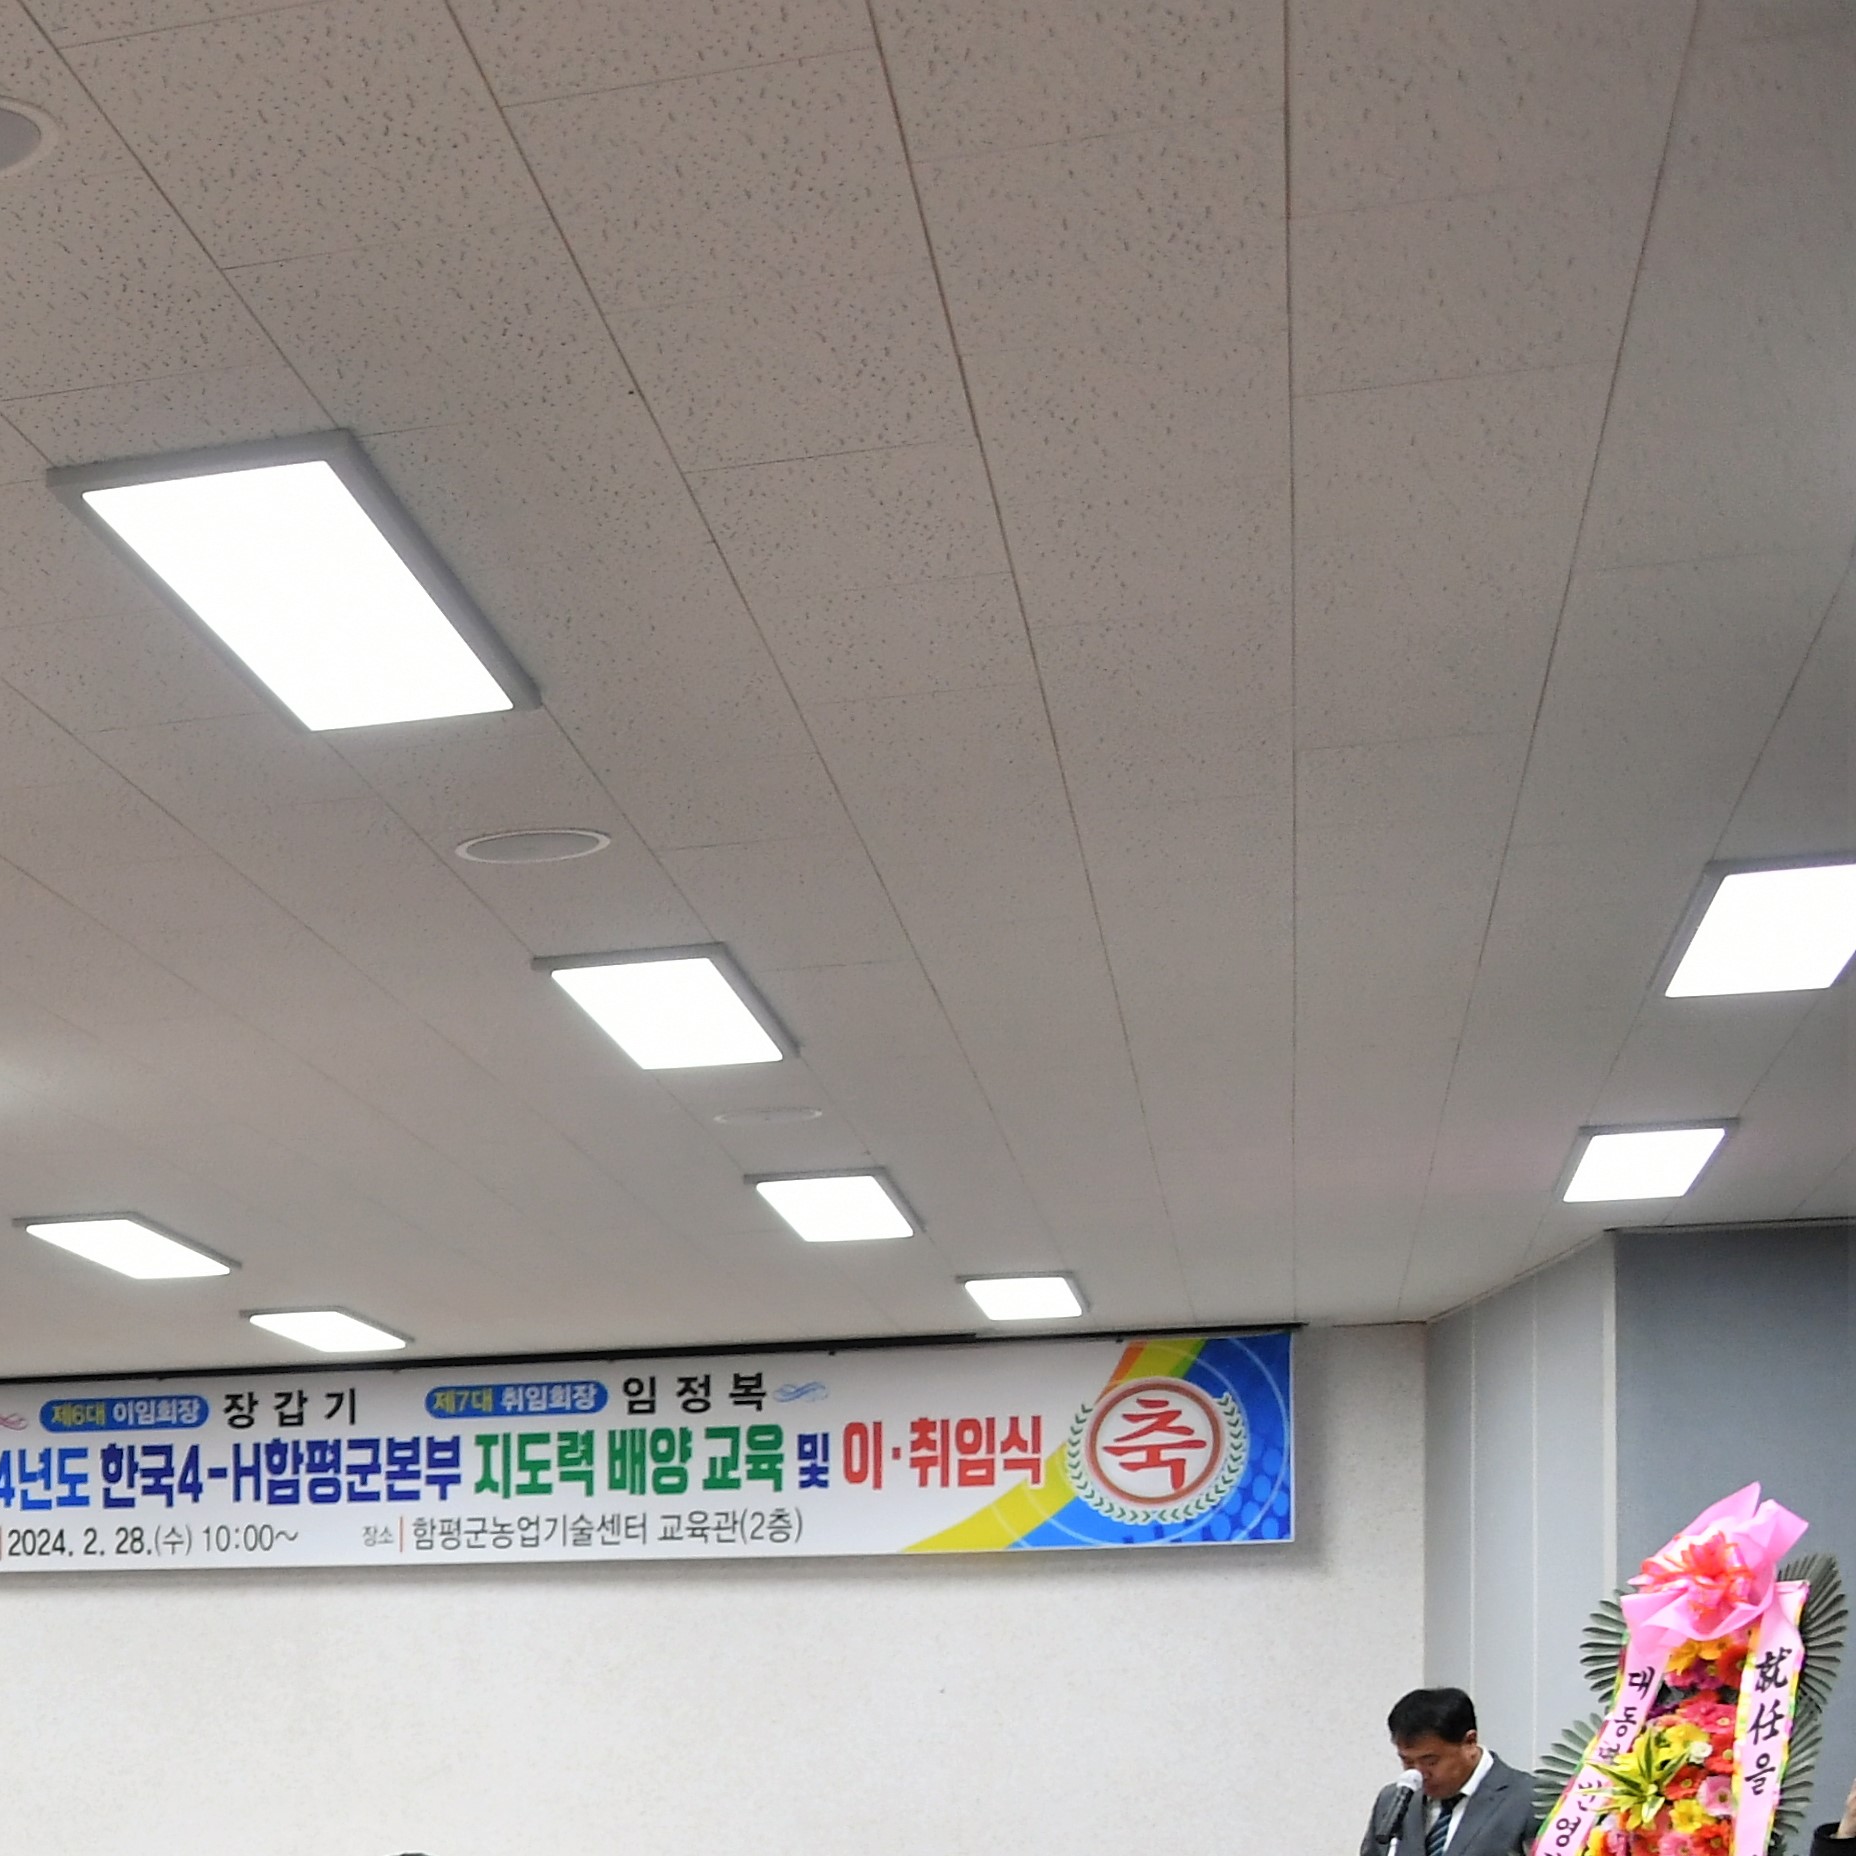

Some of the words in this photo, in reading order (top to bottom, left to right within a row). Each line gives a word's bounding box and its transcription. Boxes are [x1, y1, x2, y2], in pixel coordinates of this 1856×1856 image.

[52, 1403, 106, 1426] 제6대
[113, 1399, 200, 1424] 이임회장
[433, 1389, 494, 1414] 제7대
[501, 1385, 598, 1412] 취임회장
[100, 1435, 462, 1509] 한국4-H함평군본부
[474, 1429, 595, 1499] 지도력
[608, 1427, 692, 1495] 배양
[702, 1424, 784, 1493] 교육
[796, 1431, 830, 1488] 및
[843, 1415, 1043, 1490] 이·취임식
[1103, 1398, 1206, 1490] 축
[7, 1526, 74, 1558] 2024.
[83, 1528, 105, 1556] 2.
[362, 1525, 394, 1548] 장소
[412, 1507, 648, 1551] 함평군농업기술센터
[658, 1506, 804, 1546] 교육관(2층)
